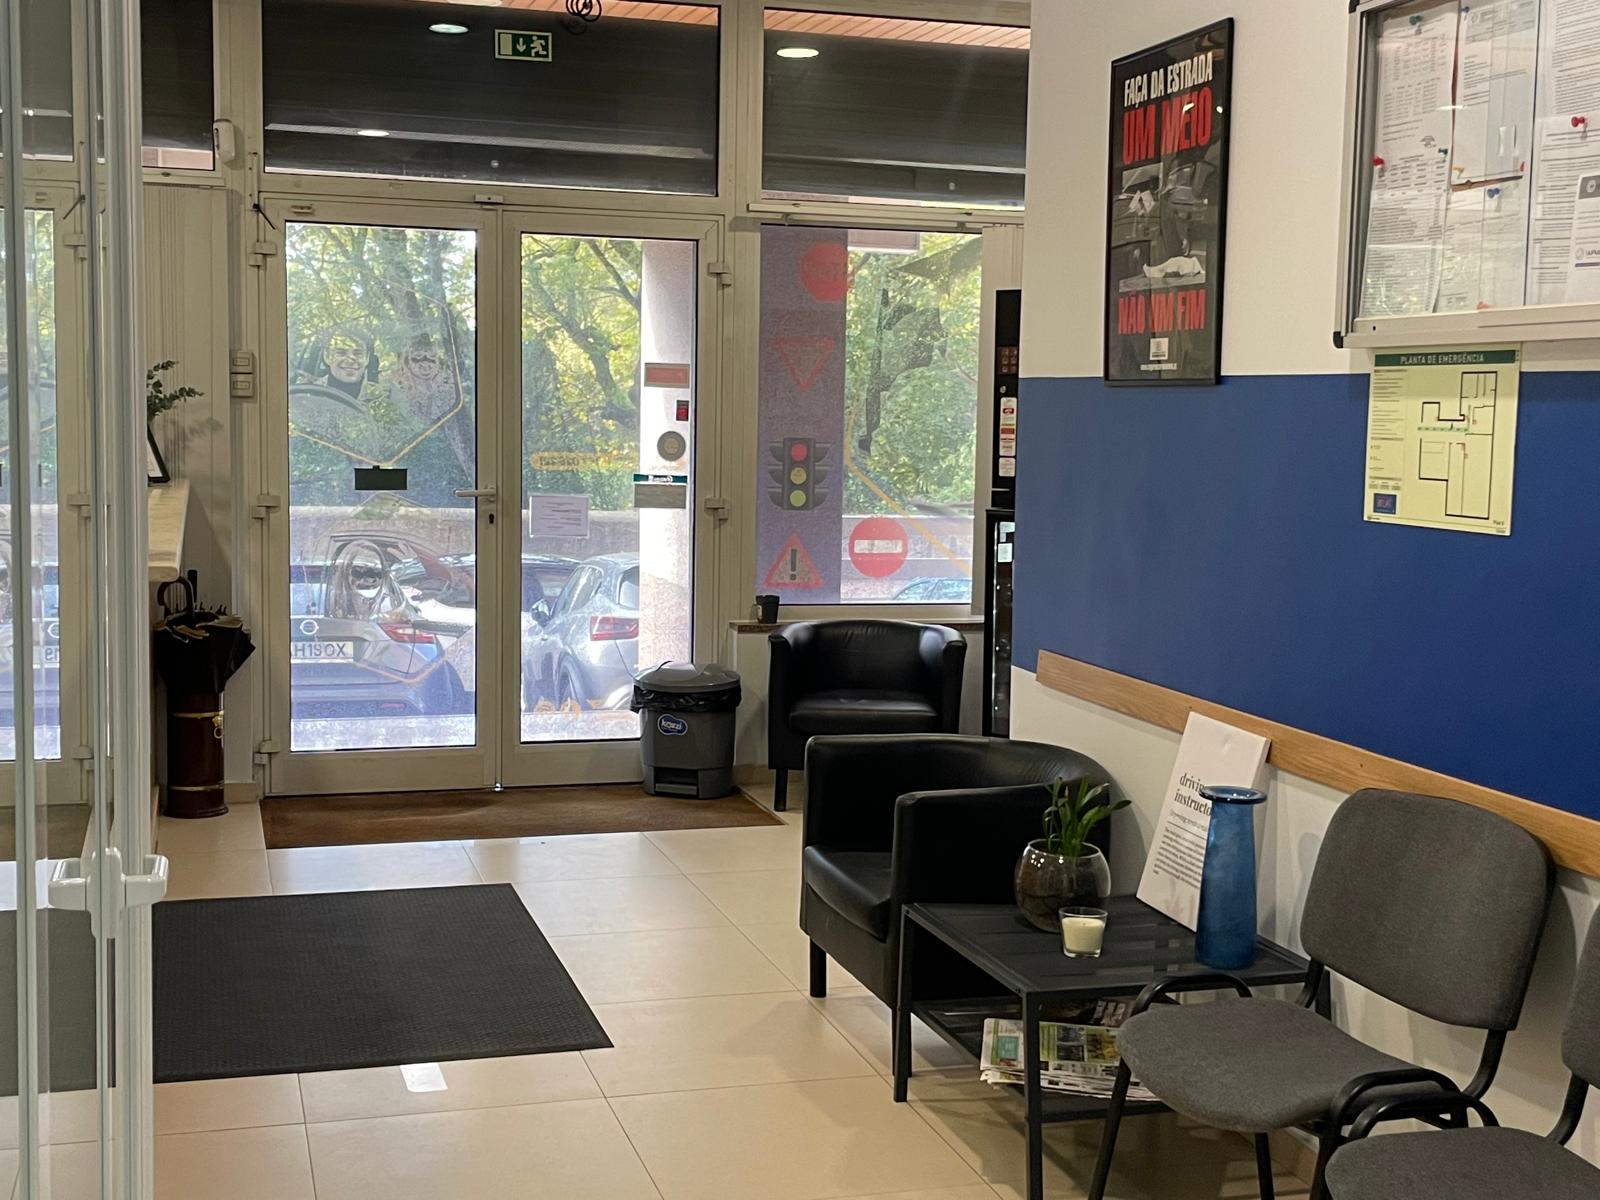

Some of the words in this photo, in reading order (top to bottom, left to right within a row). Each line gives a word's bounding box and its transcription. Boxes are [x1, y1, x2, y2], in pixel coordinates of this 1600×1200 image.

[1124, 74, 1148, 108] FAÇA
[1151, 68, 1164, 99] DA
[1167, 51, 1213, 94] ESTRADA
[1123, 103, 1156, 165] UM
[1161, 86, 1212, 156] MEIO
[1150, 290, 1174, 333] UM
[1177, 288, 1206, 330] FIM
[1400, 355, 1425, 365] PLANTA
[1427, 354, 1437, 364] DE
[1438, 352, 1485, 363] EMERGÊNCIA
[1180, 772, 1207, 793] drivin
[1174, 788, 1211, 817] instructo
